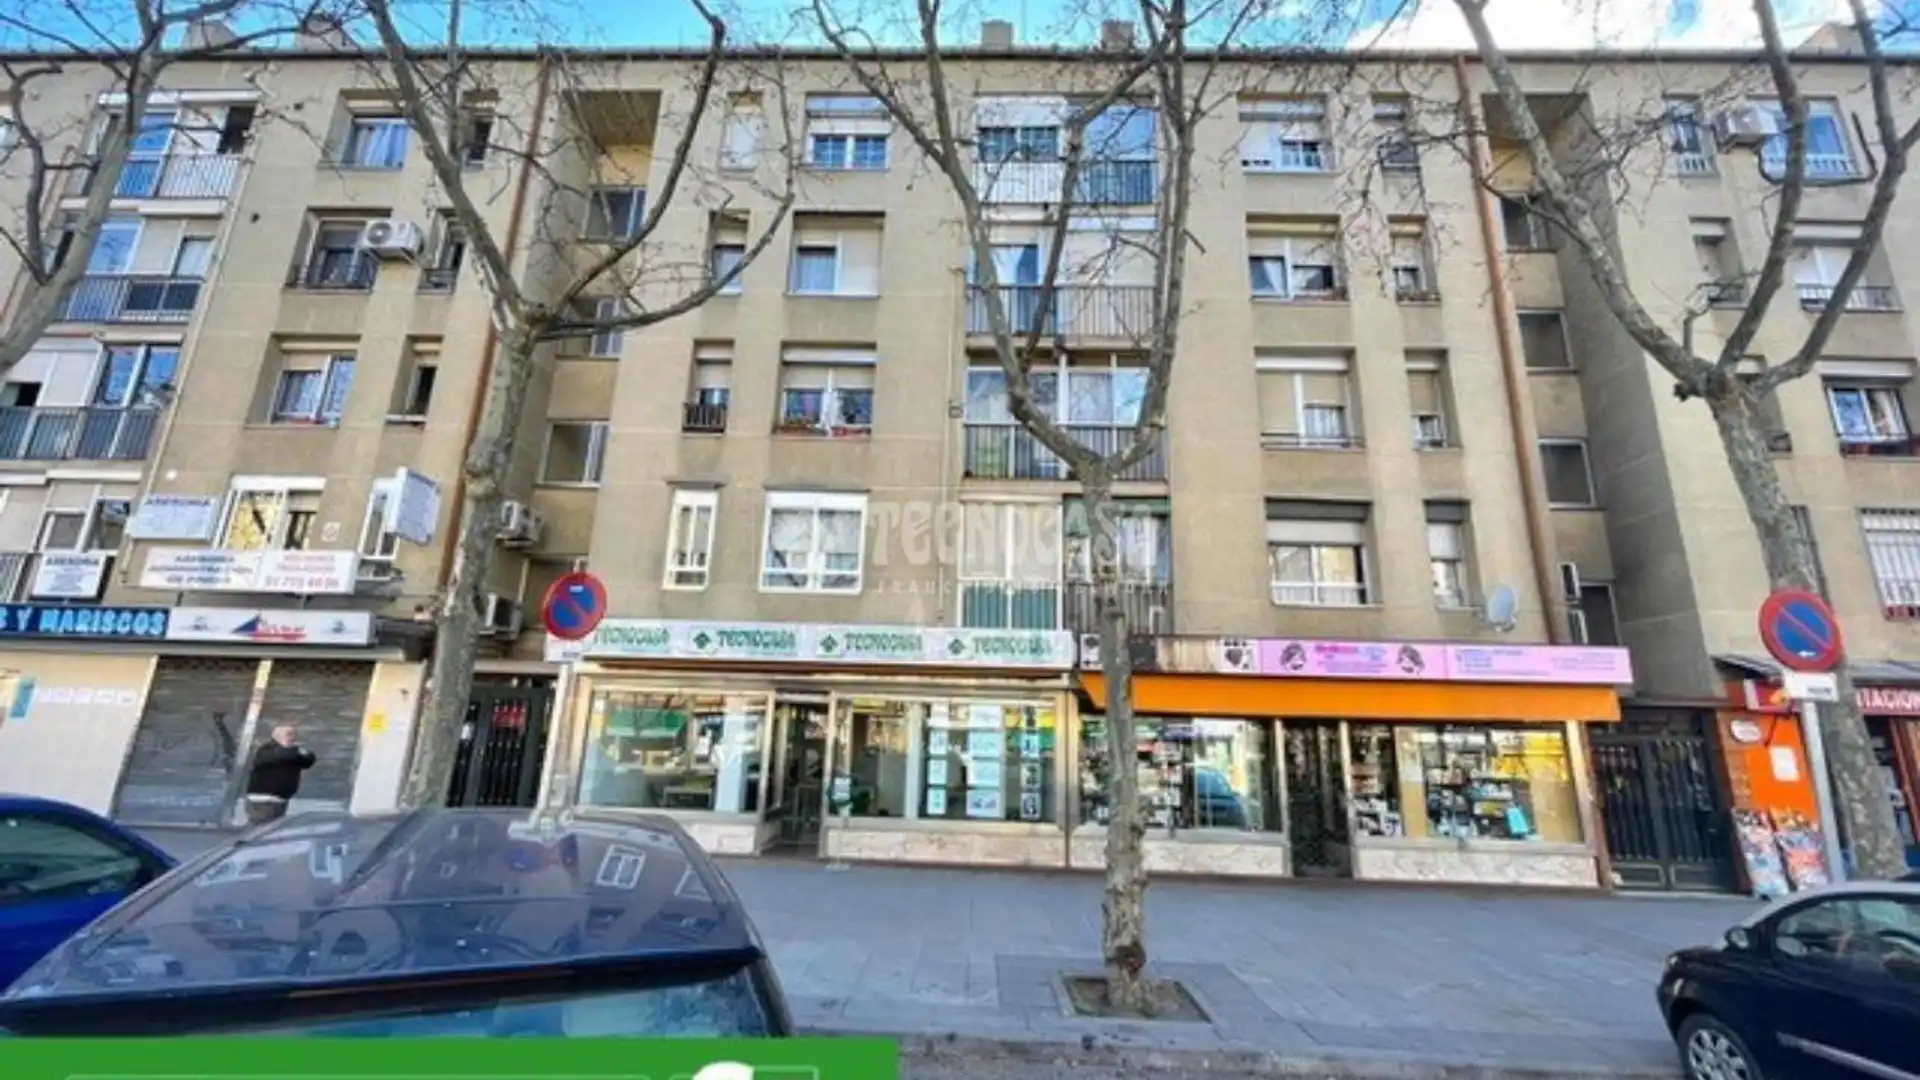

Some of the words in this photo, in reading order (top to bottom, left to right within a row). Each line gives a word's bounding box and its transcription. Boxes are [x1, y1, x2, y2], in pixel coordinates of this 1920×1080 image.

[16, 606, 33, 632] Y
[39, 608, 166, 636] MARISCOS
[716, 630, 796, 650] TECNOCASA
[845, 632, 922, 652] TECNOCASA
